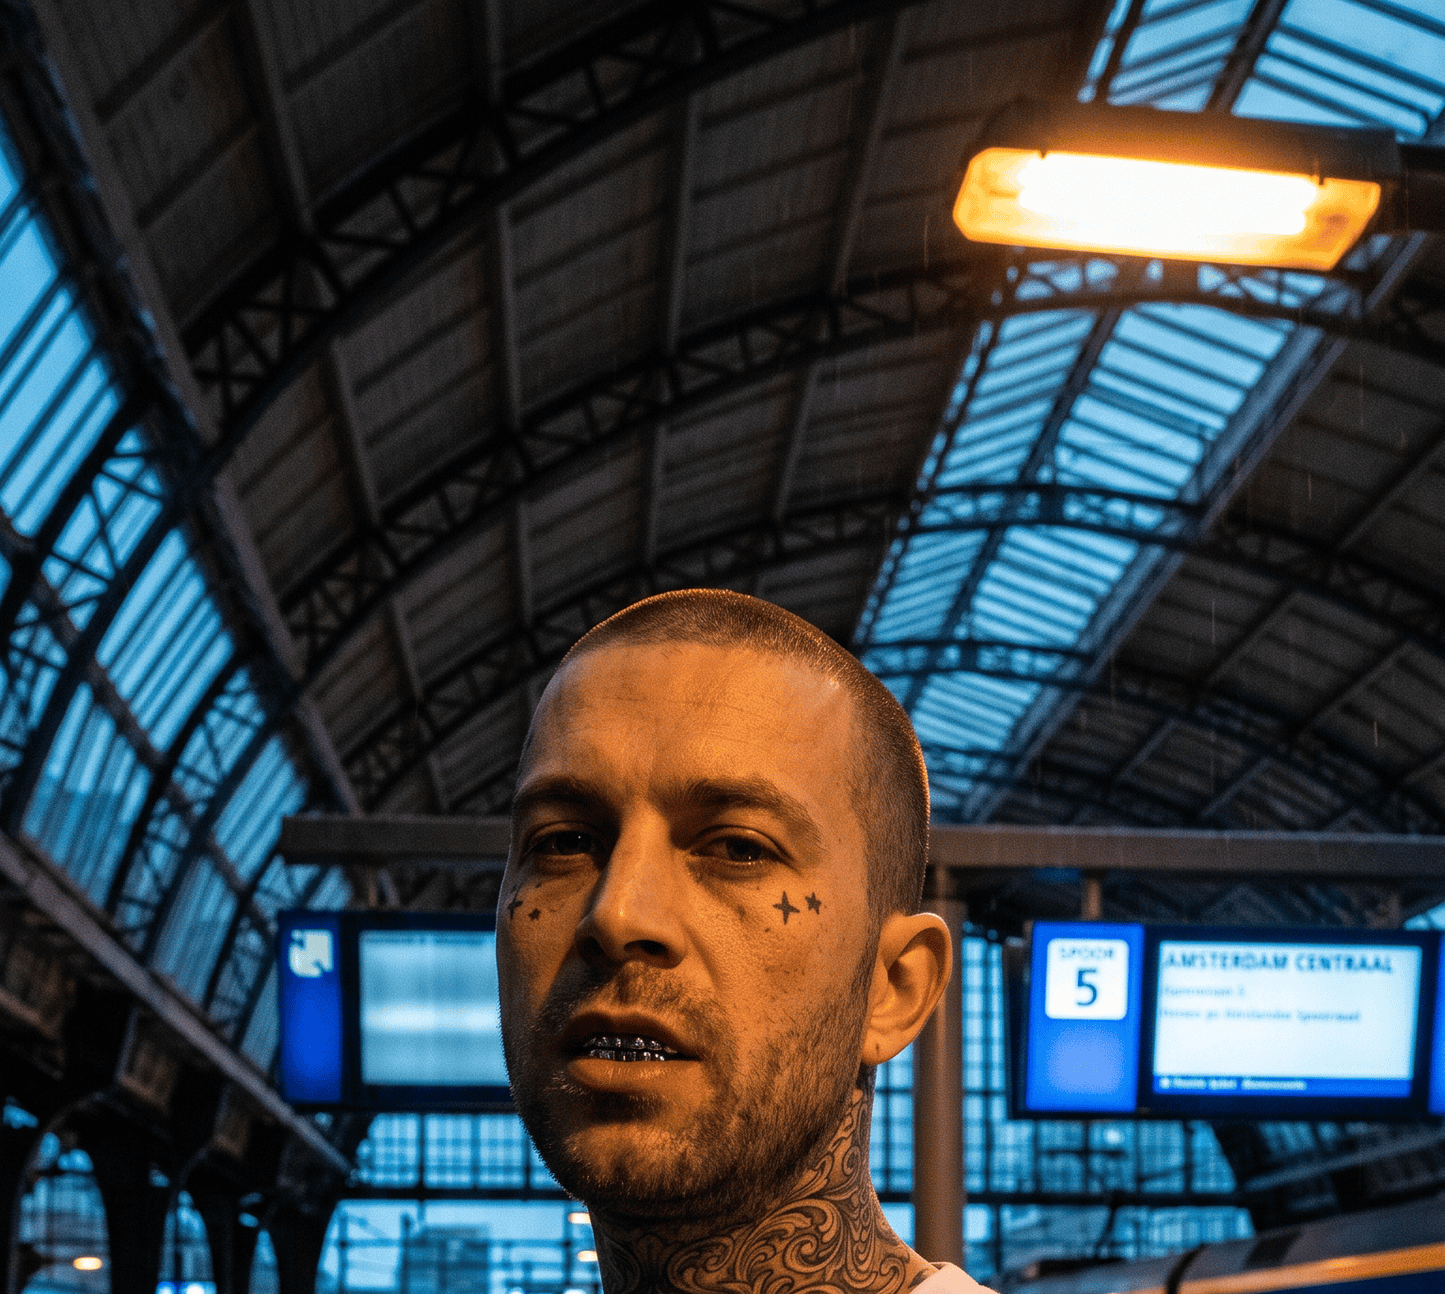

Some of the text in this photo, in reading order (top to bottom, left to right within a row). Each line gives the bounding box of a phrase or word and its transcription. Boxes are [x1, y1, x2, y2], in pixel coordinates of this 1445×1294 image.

[1162, 952, 1393, 974] AMSTERDAM CENTRAAL
[1076, 967, 1098, 1006] 5
